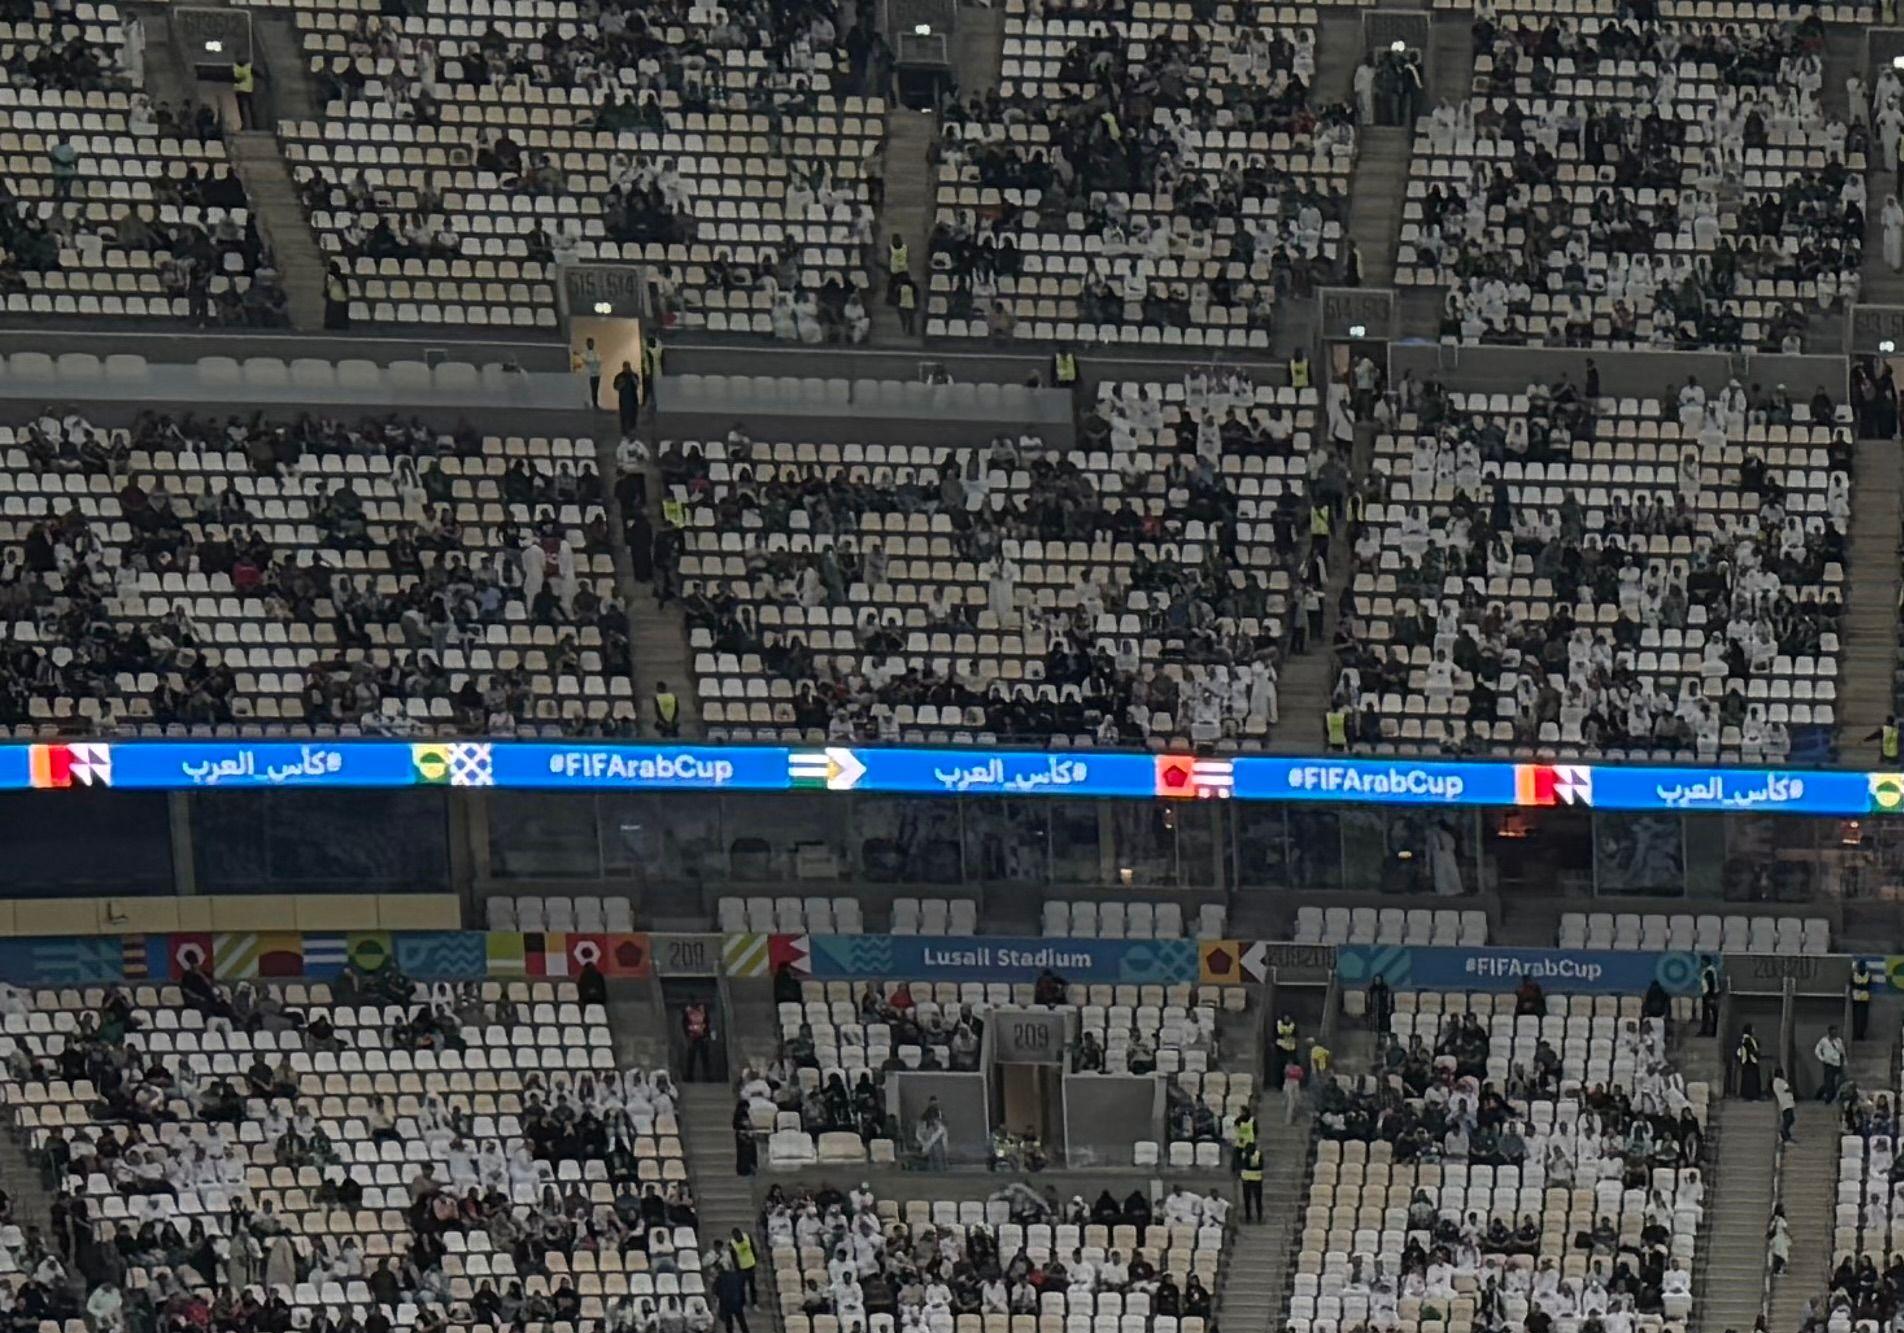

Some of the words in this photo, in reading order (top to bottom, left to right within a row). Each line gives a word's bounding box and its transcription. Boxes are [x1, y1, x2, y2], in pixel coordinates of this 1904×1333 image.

[550, 754, 733, 782] #FIFArabCup
[1288, 768, 1463, 799] #FIFArabCup
[923, 947, 990, 966] Lusail
[997, 949, 1092, 968] Stadium
[1465, 957, 1602, 981] #FIFArabCup
